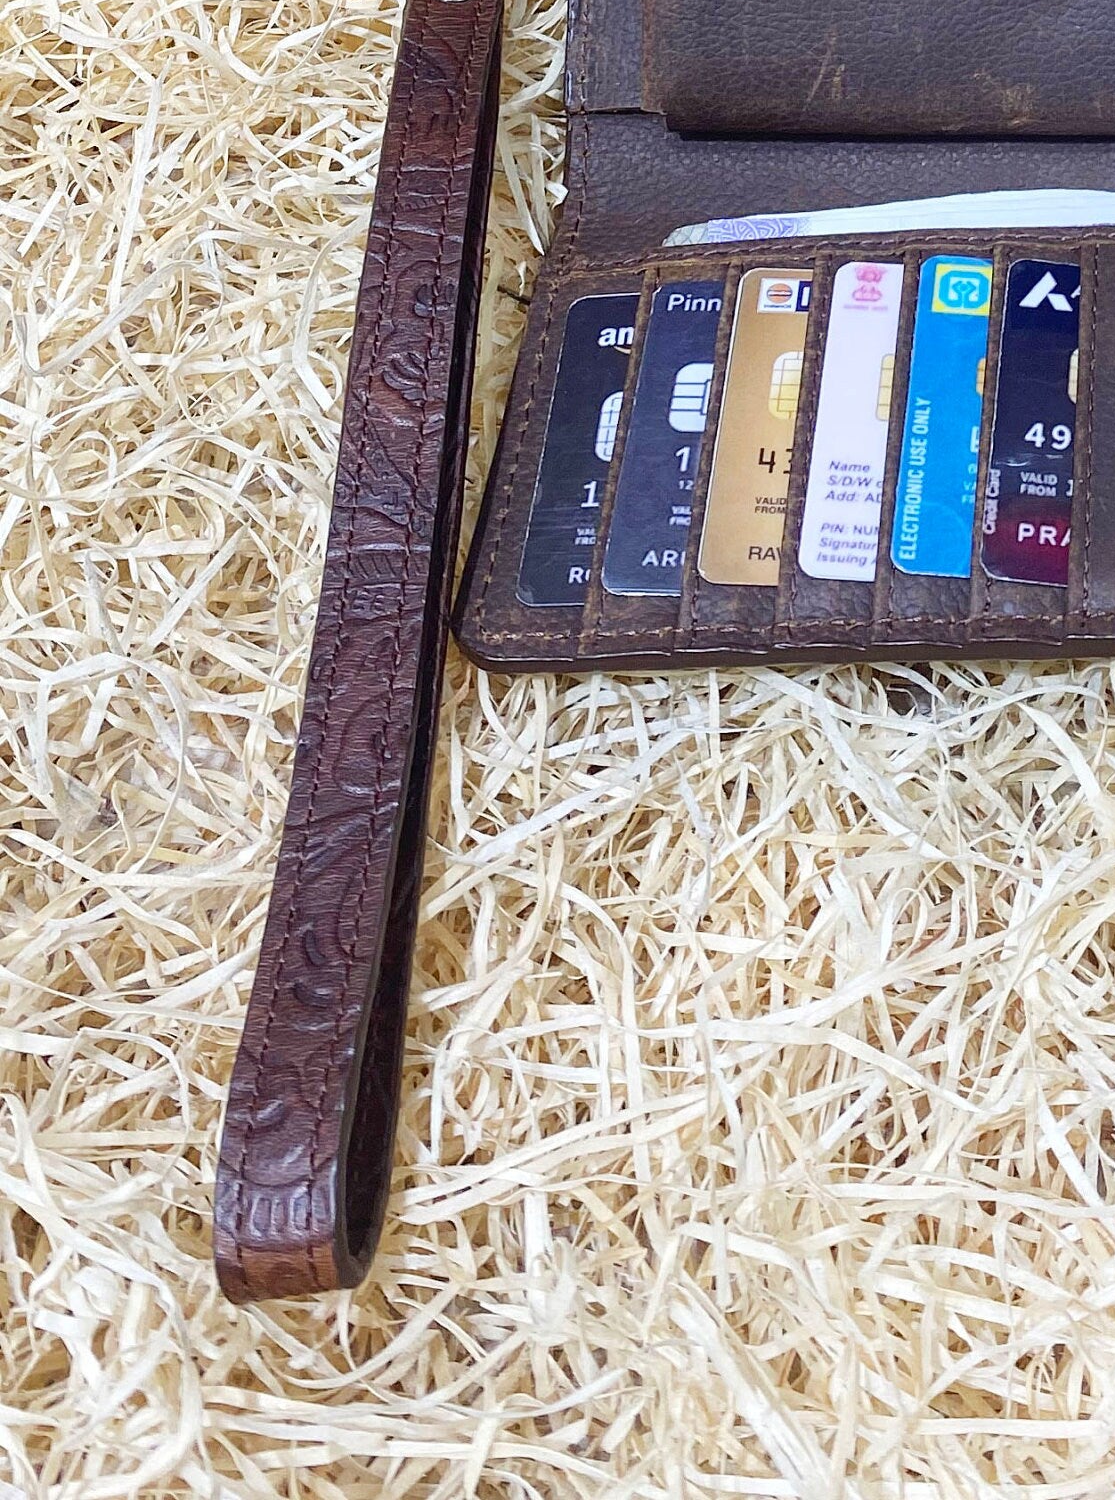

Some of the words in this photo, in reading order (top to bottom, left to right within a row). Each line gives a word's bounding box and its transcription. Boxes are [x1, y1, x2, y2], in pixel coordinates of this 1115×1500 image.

[667, 293, 722, 312] Pinn
[911, 397, 931, 436] ONLY
[1024, 422, 1072, 450] 49
[908, 436, 928, 467] USE
[829, 460, 870, 473] Name
[827, 475, 872, 488] S/D/W
[1020, 471, 1058, 486] VALID
[581, 480, 600, 508] 1
[1020, 483, 1057, 497] FROM
[755, 496, 788, 506] VALID
[898, 468, 925, 561] ELECTRONIC
[816, 551, 868, 567] Issuing
